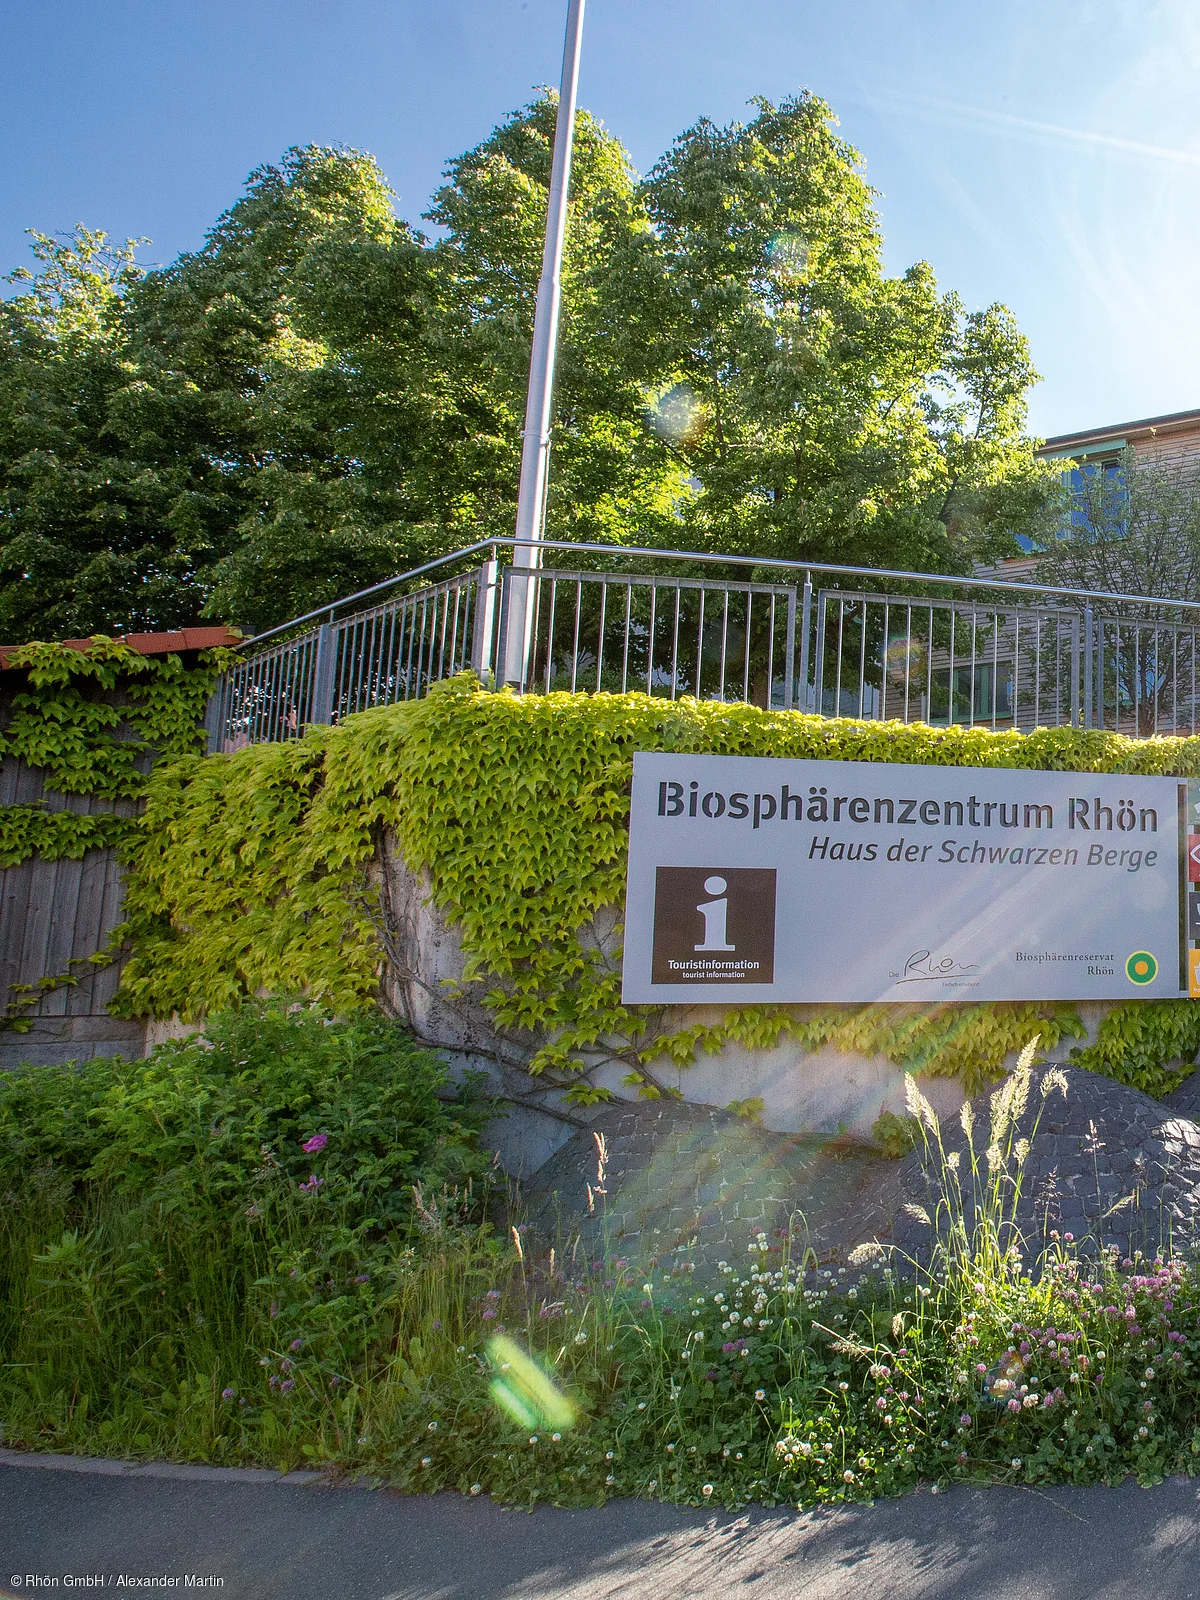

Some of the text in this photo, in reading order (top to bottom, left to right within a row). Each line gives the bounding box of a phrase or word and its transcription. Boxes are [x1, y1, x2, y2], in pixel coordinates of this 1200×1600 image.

[657, 781, 1158, 832] Biosphärenzentrum Rhön
[808, 836, 1158, 873] Haus der Schwarzen Berge
[1015, 951, 1115, 964] Biosphärenreservat
[668, 959, 760, 969] Touristinformation
[682, 970, 745, 978] tourist information
[1087, 965, 1115, 976] Rhön
